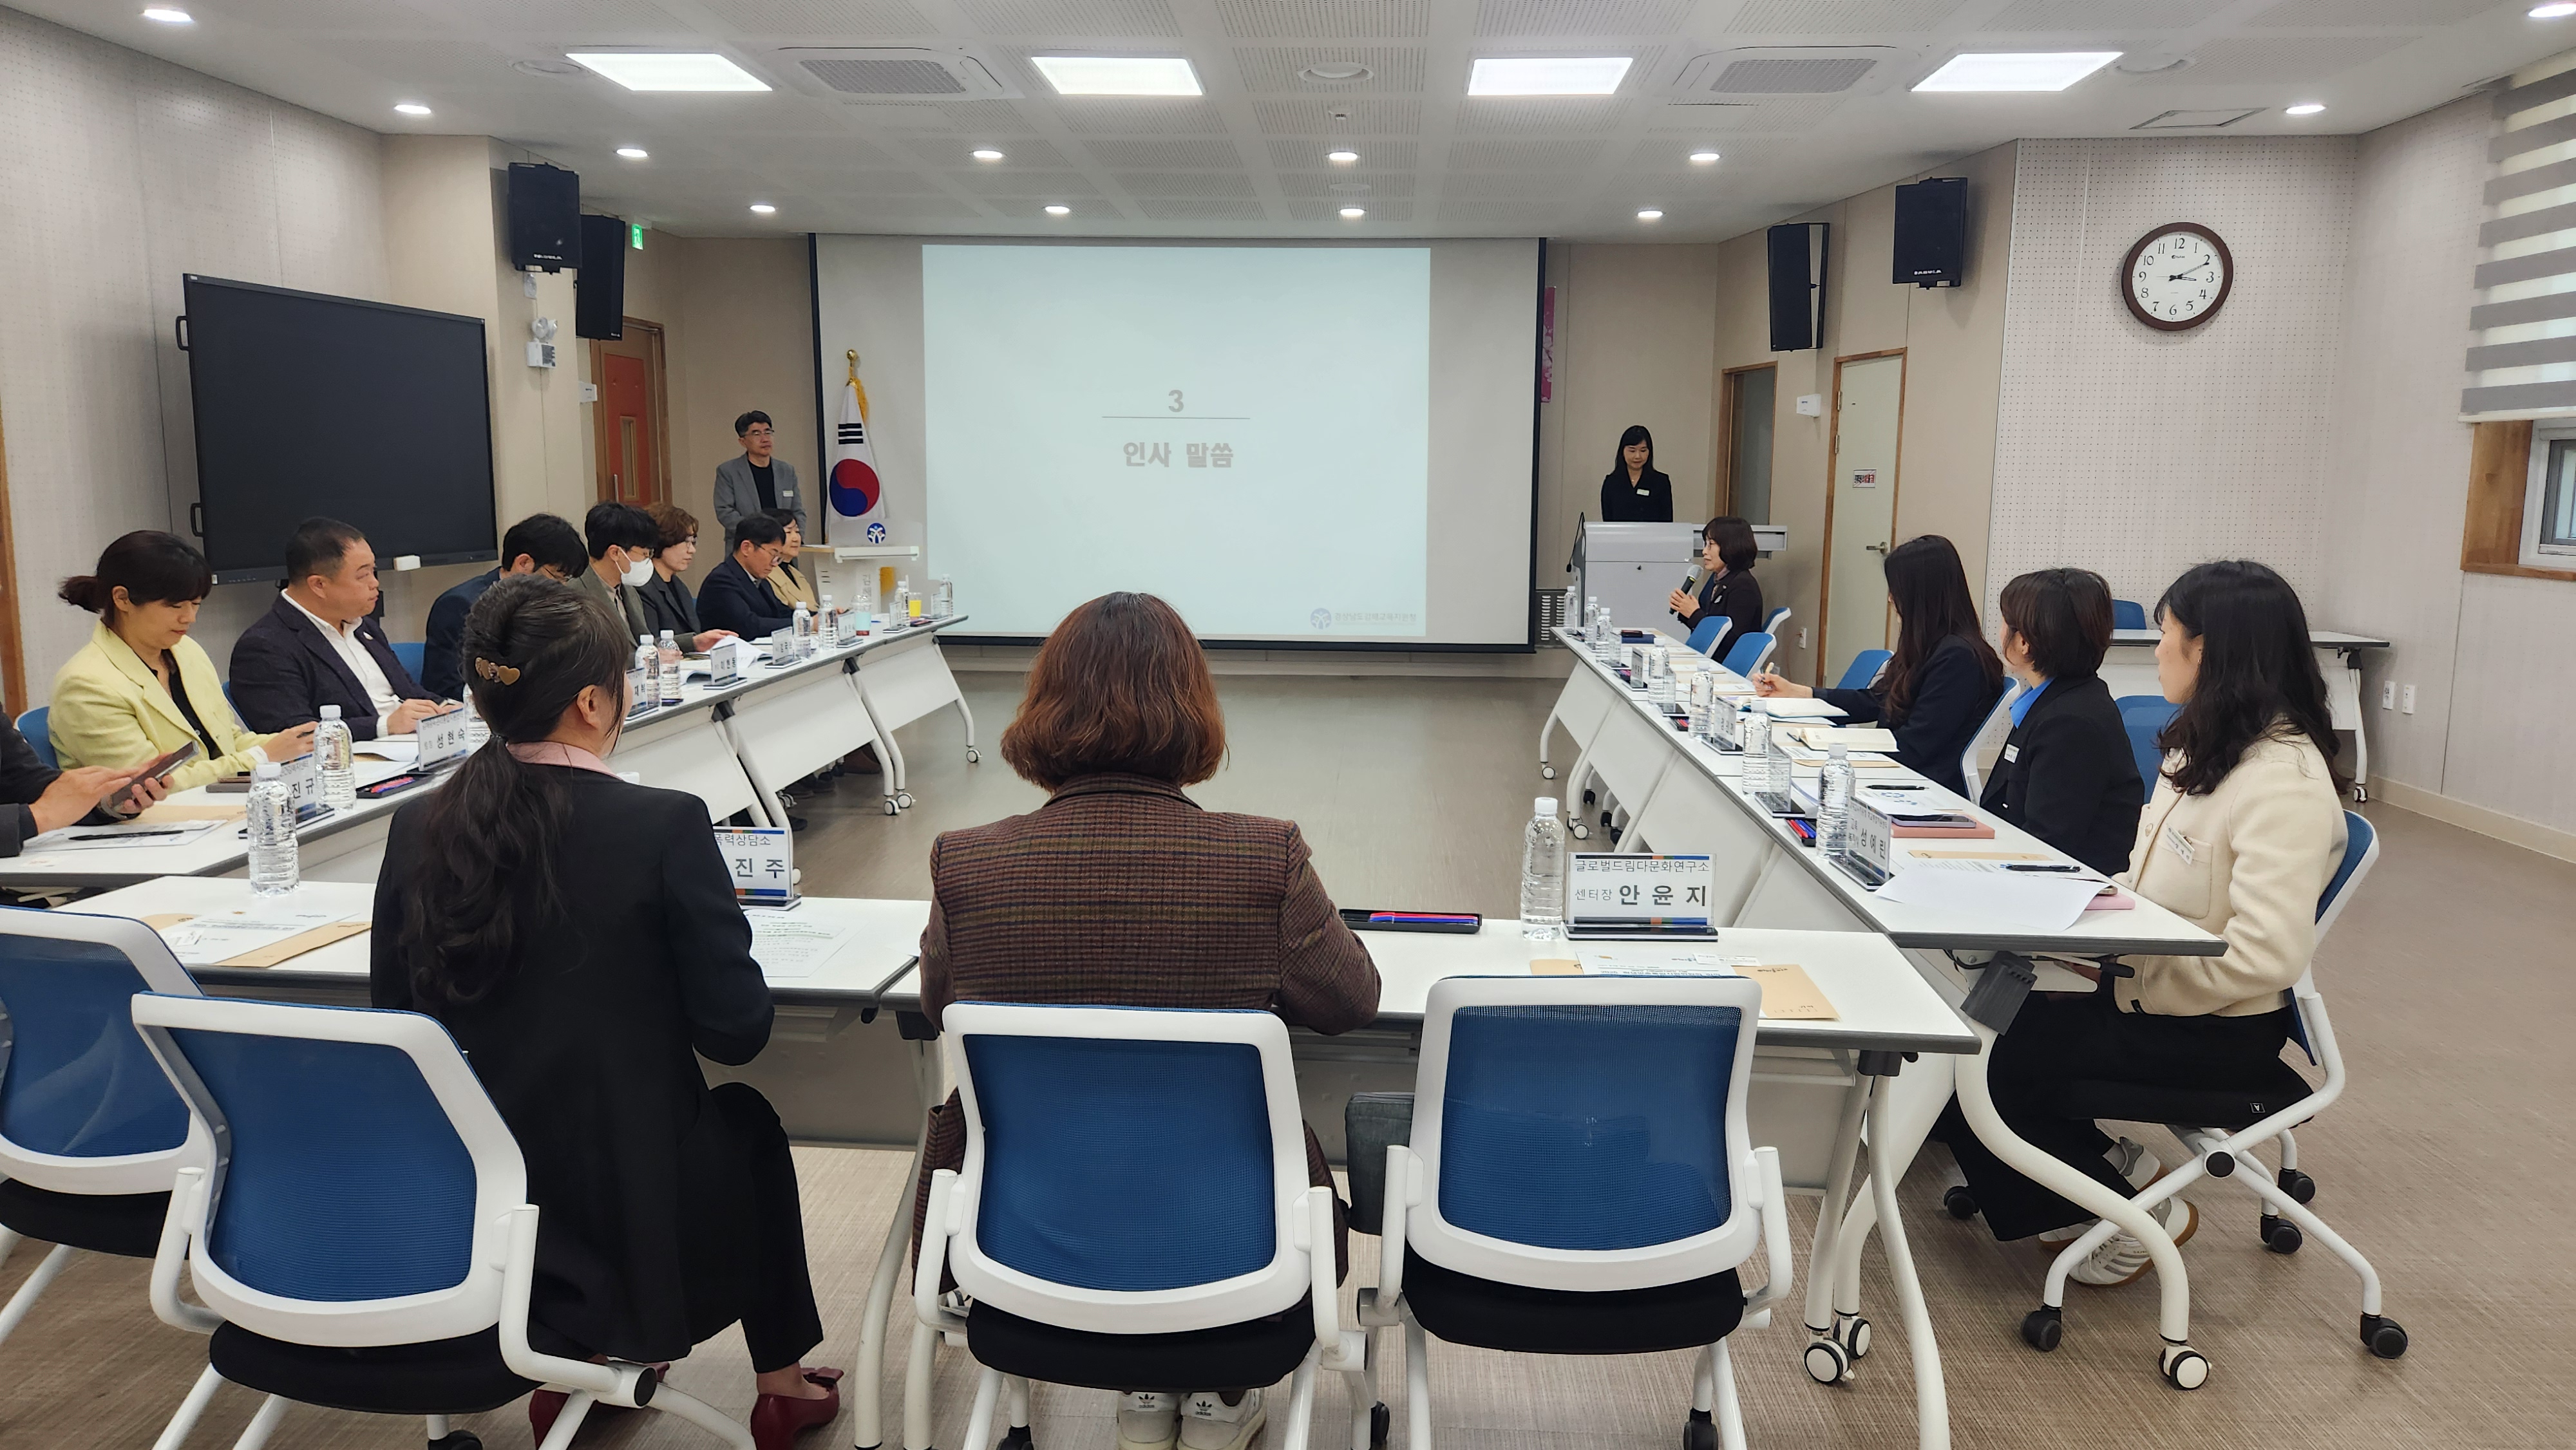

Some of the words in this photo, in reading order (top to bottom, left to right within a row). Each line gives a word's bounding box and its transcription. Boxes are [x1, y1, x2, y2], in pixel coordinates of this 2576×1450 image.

[2157, 243, 2165, 254] 11
[2174, 238, 2185, 249] 12
[2194, 242, 2198, 254] 1
[2143, 255, 2154, 266] 10
[2203, 254, 2210, 265] 2
[2139, 271, 2146, 283] 9
[2206, 272, 2214, 283] 3
[2141, 287, 2149, 298] 8
[2199, 289, 2207, 299] 4
[2152, 301, 2159, 312] 7
[2169, 304, 2177, 315] 6
[2186, 300, 2193, 311] 5
[1168, 389, 1184, 413] 3
[1122, 442, 1172, 467] 인사
[1186, 442, 1234, 468] 말씀
[1575, 860, 1710, 873] 글로벌드림다문화연구소
[1575, 889, 1612, 901] 센터장
